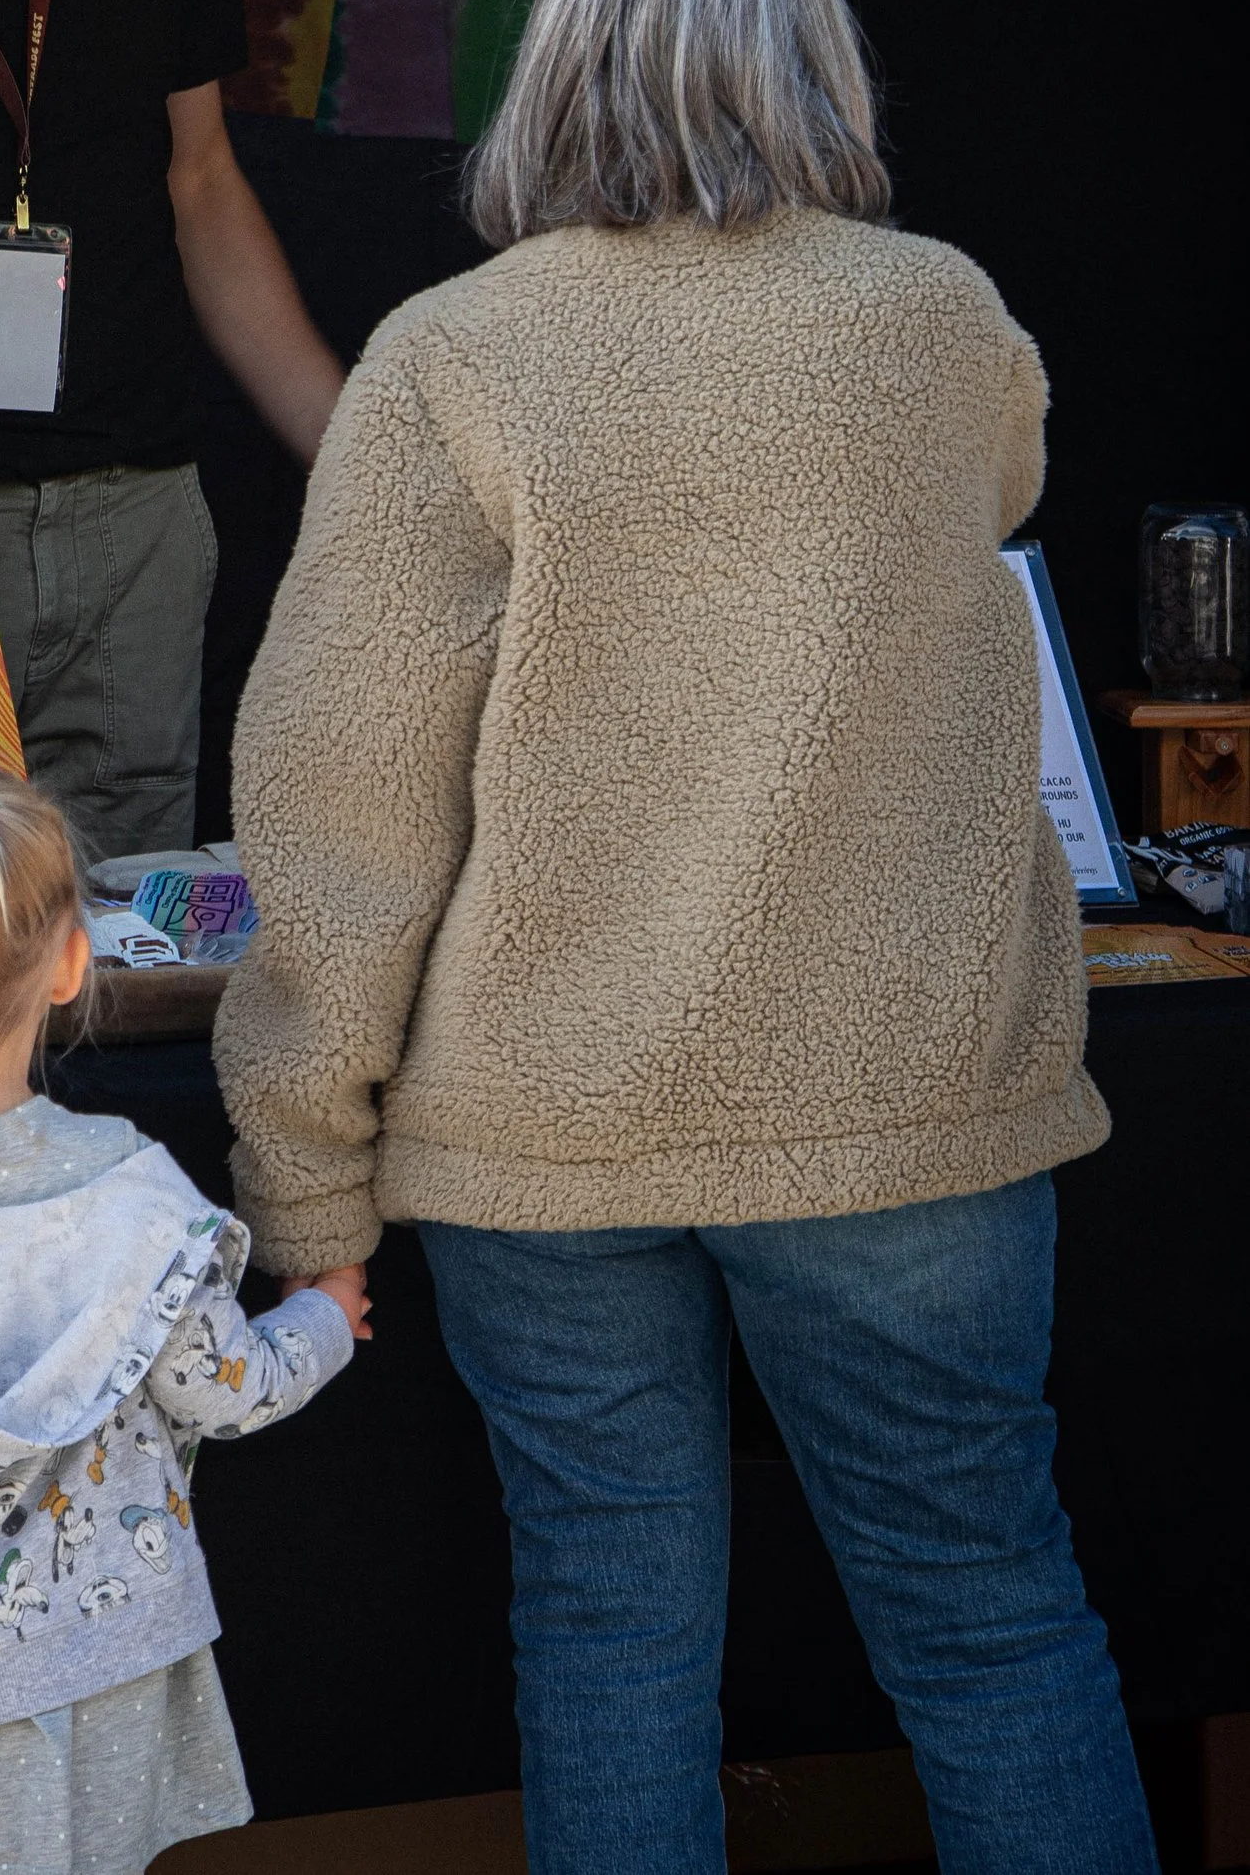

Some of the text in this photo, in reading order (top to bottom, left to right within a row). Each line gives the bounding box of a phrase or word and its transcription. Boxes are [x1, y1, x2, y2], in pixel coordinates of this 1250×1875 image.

[1040, 776, 1072, 787] CACAO
[1040, 790, 1079, 801] ROUNDS
[1057, 818, 1072, 829] HU
[1066, 832, 1086, 842] OUR
[1179, 829, 1215, 845] ORGANIC
